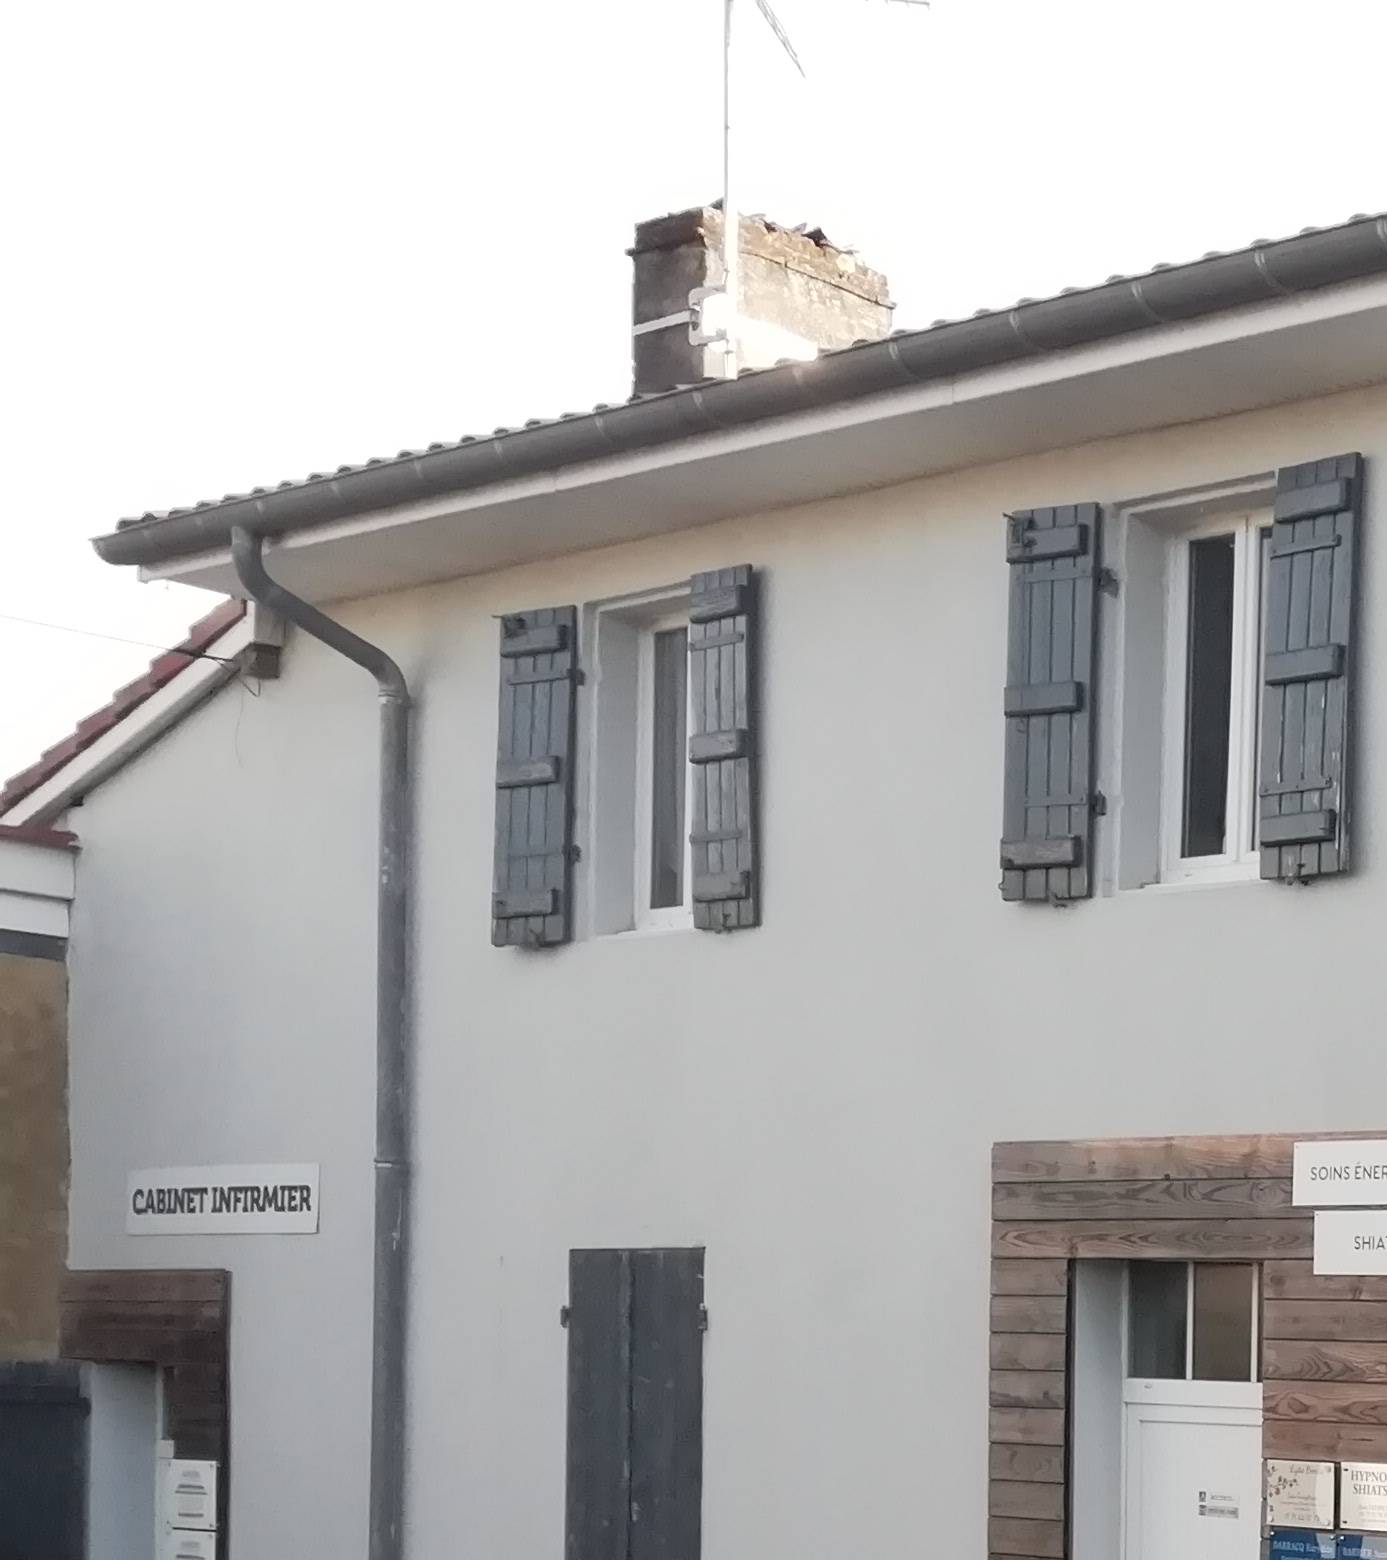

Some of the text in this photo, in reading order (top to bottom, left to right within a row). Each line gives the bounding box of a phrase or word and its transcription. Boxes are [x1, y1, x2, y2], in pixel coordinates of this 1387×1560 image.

[1310, 1165, 1351, 1181] SOINS
[132, 1185, 312, 1215] CABINET INFIRMIER
